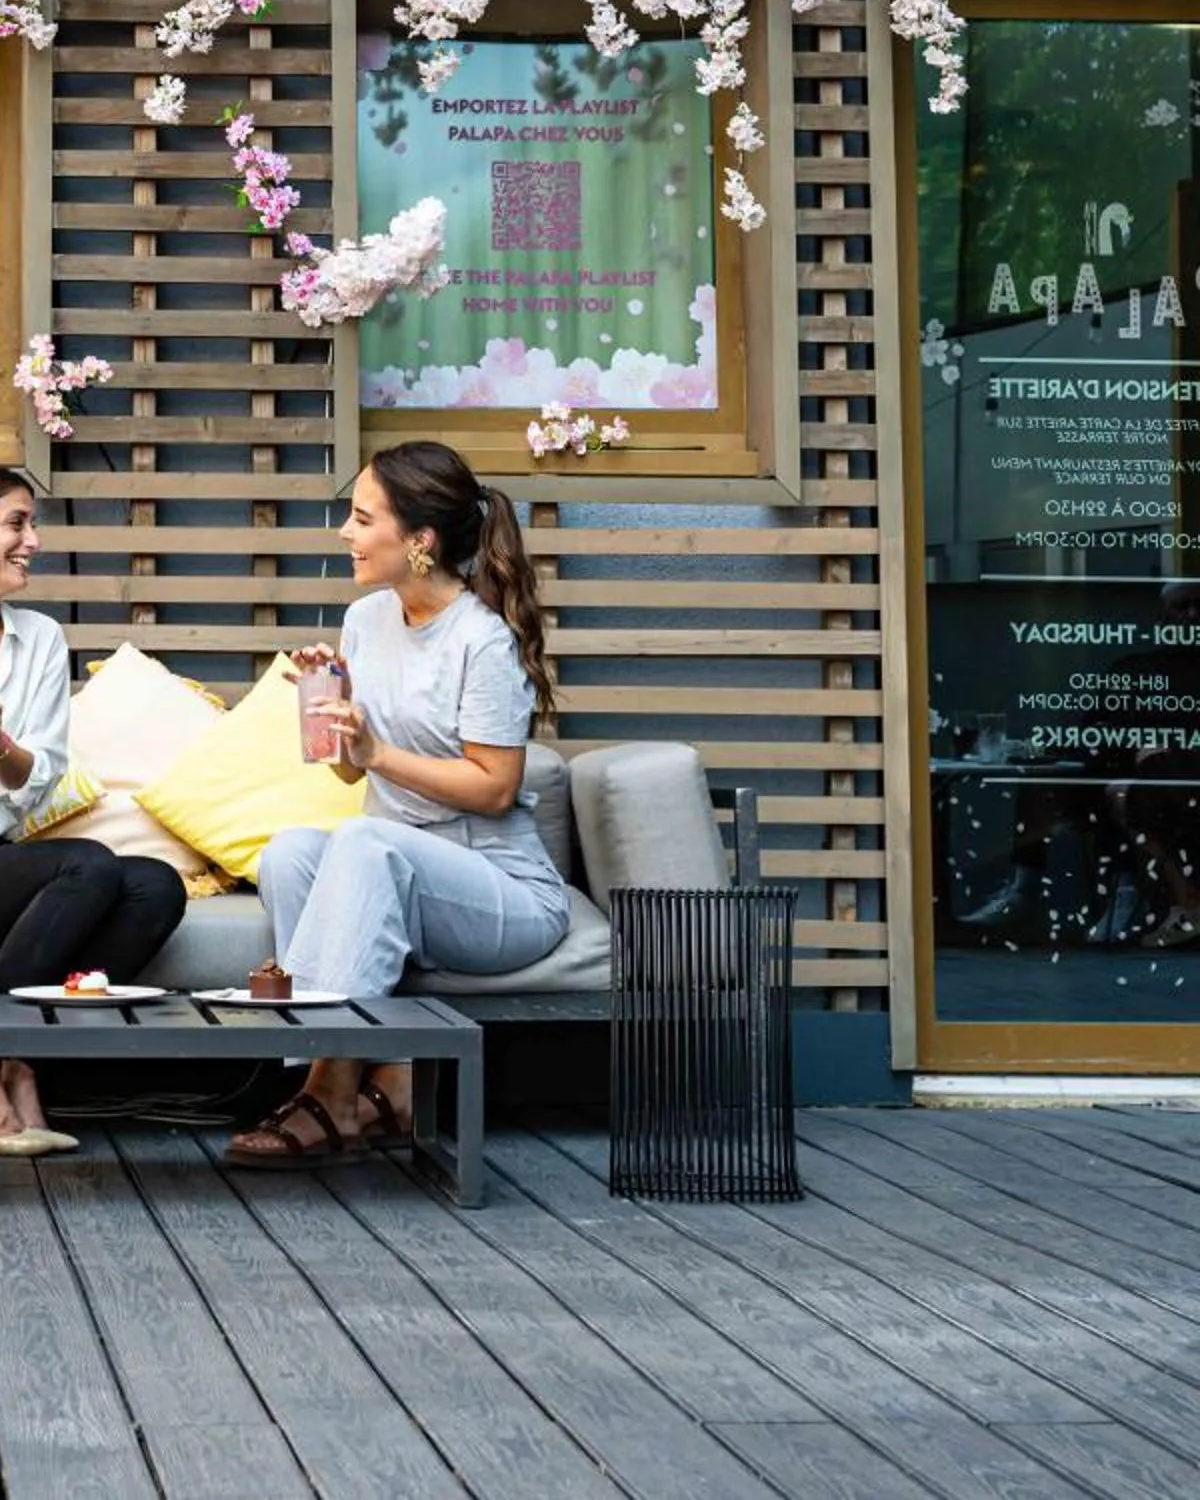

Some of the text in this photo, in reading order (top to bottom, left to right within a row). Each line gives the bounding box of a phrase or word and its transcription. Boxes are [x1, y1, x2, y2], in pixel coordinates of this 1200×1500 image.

[431, 99, 639, 115] EMPORTEZ LA PLAYLIST
[448, 126, 625, 143] PALAPA CHEZ VOUS
[465, 269, 502, 285] THE
[504, 269, 574, 286] PALAPA
[577, 270, 657, 287] PLAYLIST
[462, 297, 614, 314] HOME WITH YOU
